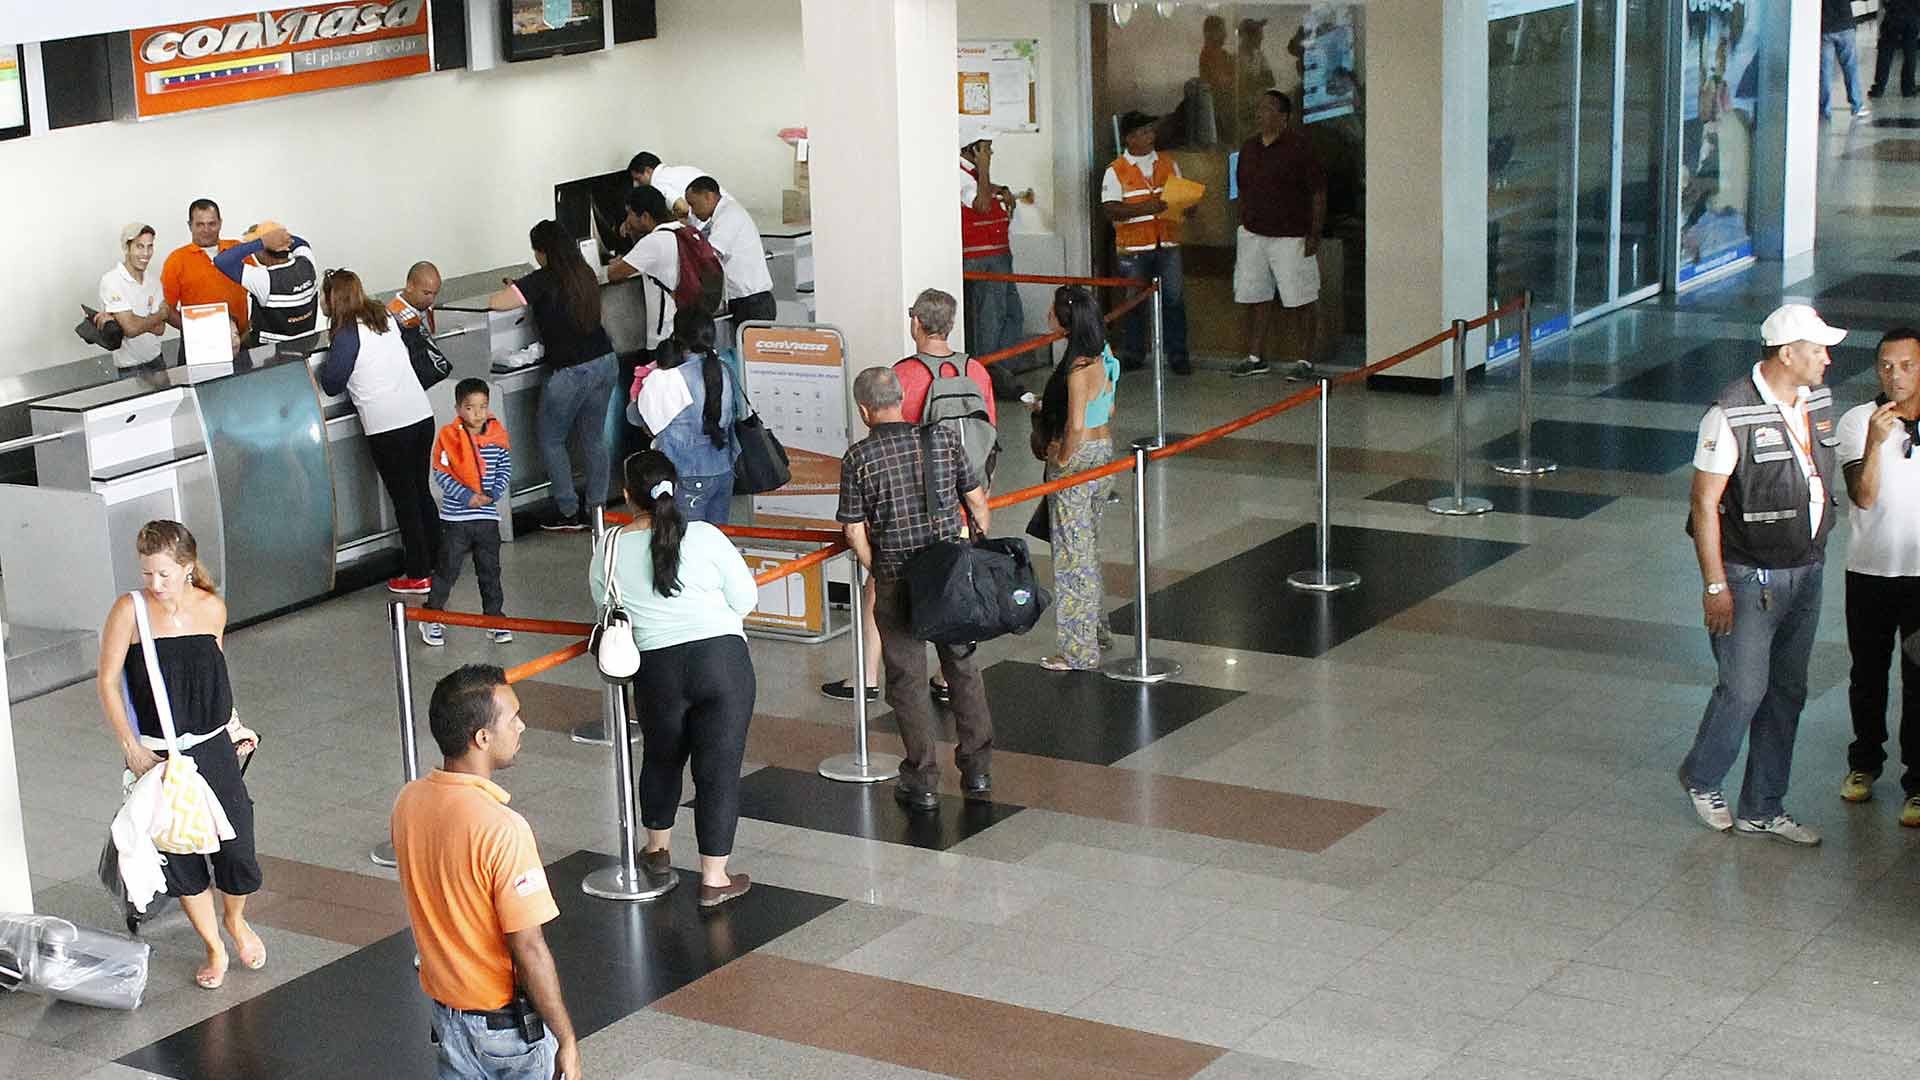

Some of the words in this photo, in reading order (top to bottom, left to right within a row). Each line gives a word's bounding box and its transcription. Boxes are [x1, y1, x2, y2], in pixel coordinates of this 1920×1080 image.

[304, 52, 317, 66] El
[320, 47, 361, 65] placer
[384, 39, 417, 54] volar
